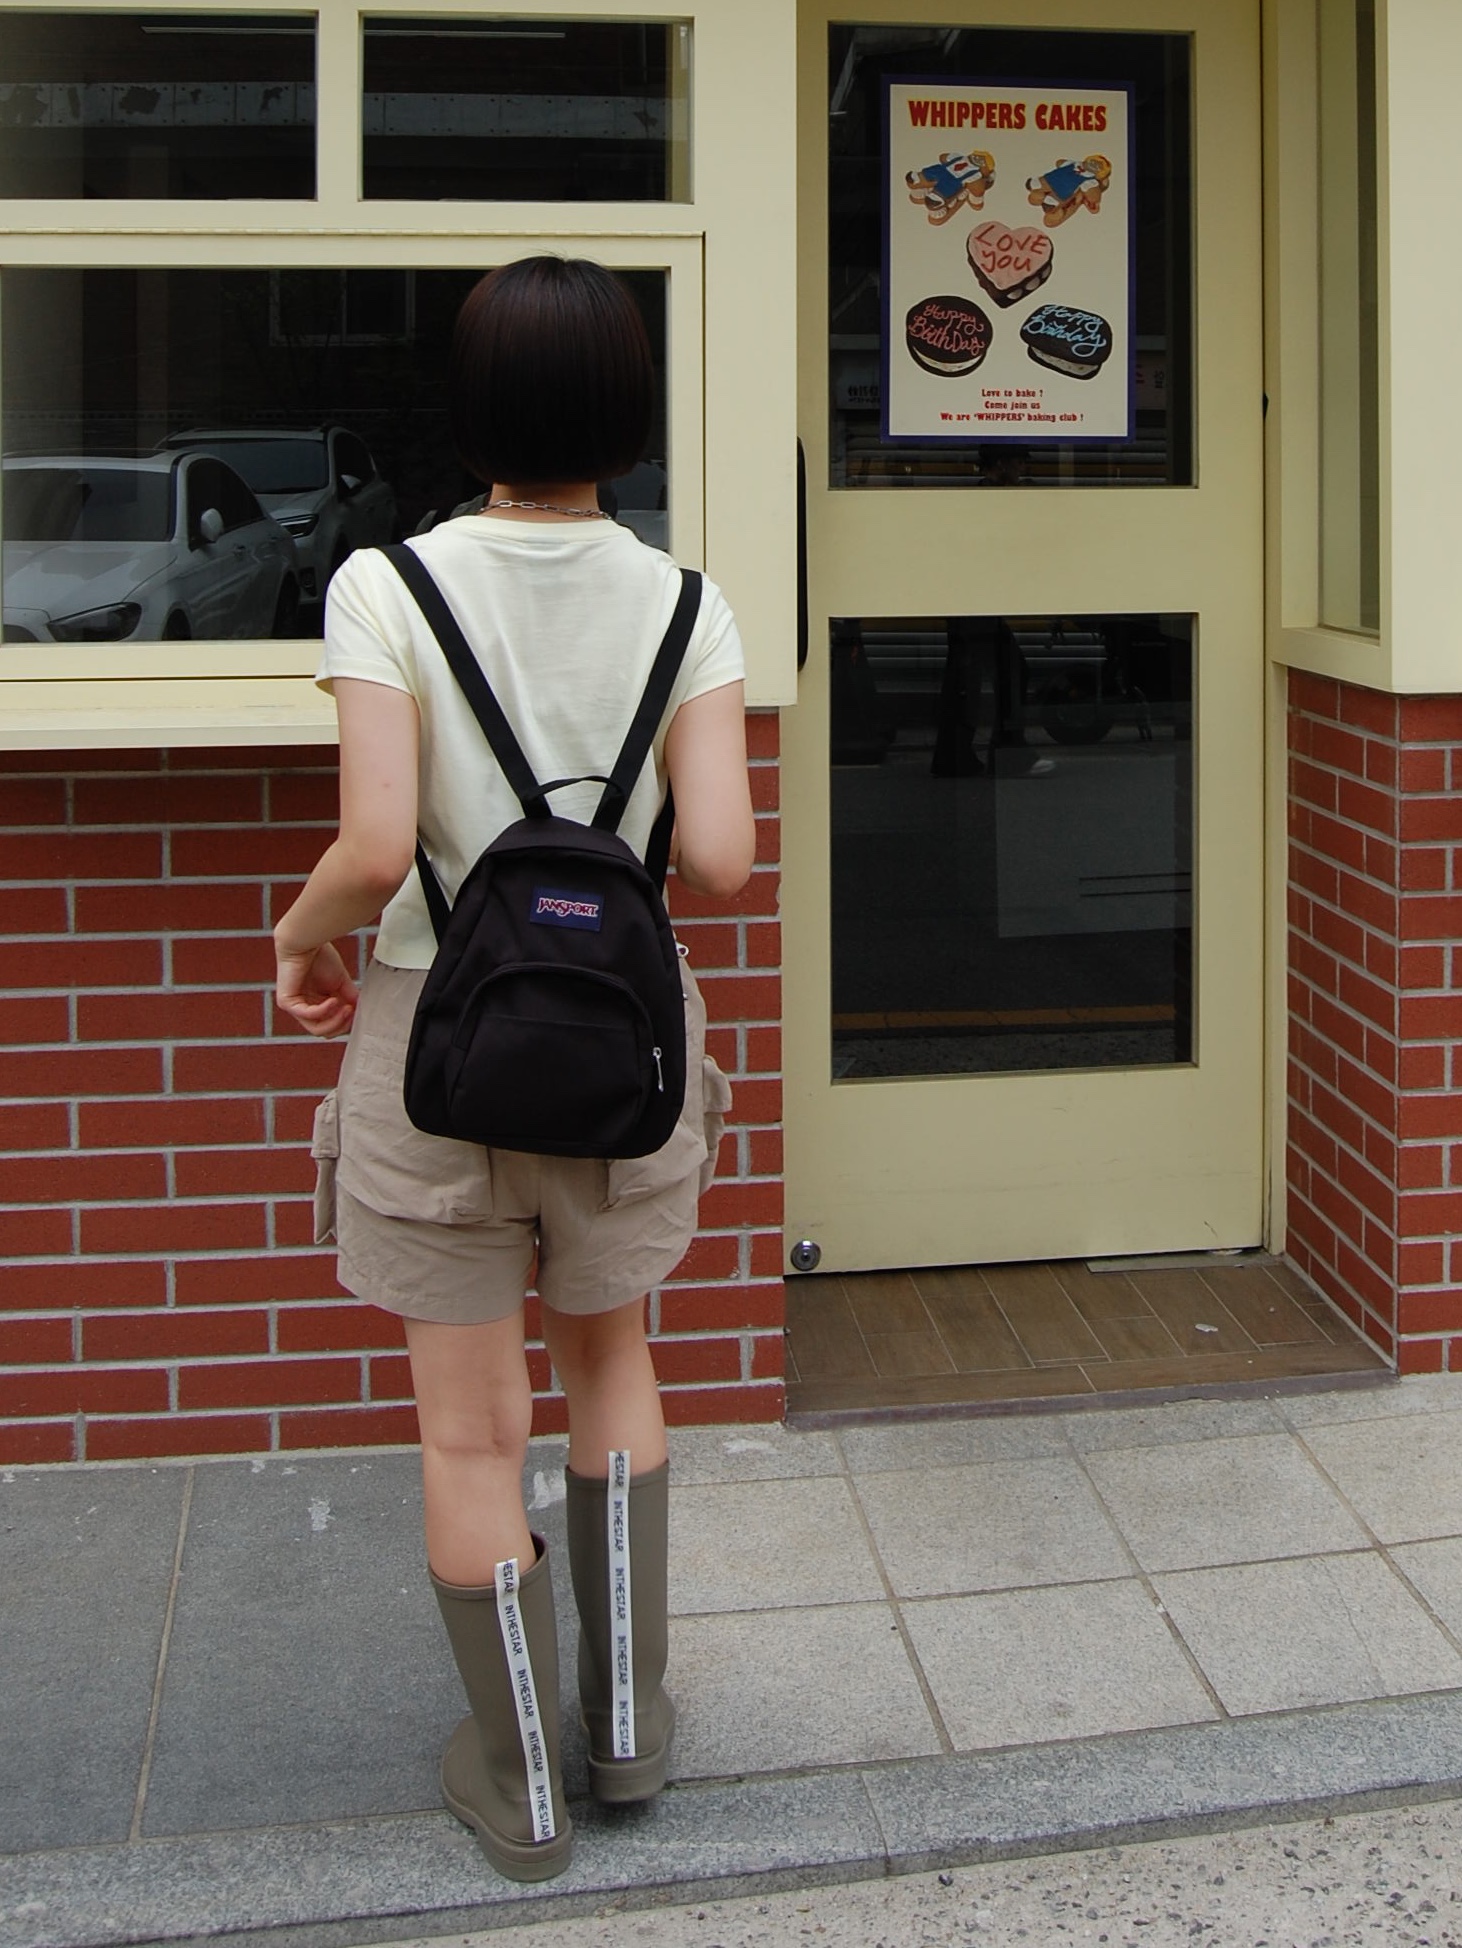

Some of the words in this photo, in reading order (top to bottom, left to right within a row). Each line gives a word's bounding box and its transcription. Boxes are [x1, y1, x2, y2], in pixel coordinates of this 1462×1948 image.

[908, 100, 1026, 129] WHIPPERS
[1035, 103, 1107, 132] CAKES
[975, 225, 1049, 255] LOVE
[923, 304, 985, 336] Happy
[1042, 305, 1104, 333] Happy
[981, 389, 1000, 397] Love
[1004, 389, 1013, 397] to
[1016, 389, 1036, 397] bake
[984, 401, 1007, 409] Come
[1010, 401, 1028, 410] join
[940, 412, 953, 420] We
[1027, 413, 1056, 422] baking
[1059, 413, 1077, 421] club
[536, 897, 599, 917] JANSPORT
[614, 1500, 624, 1553] INTHESTAR
[615, 1567, 626, 1621] INTHESTAR
[617, 1635, 628, 1686] INTHESTAR
[505, 1604, 522, 1656] INTHESTAR
[517, 1668, 534, 1720] INTHESTAR
[527, 1730, 543, 1773] INTHESTAR
[535, 1784, 550, 1838] INTHESTAR
[618, 1701, 630, 1755] INTHESTAR
